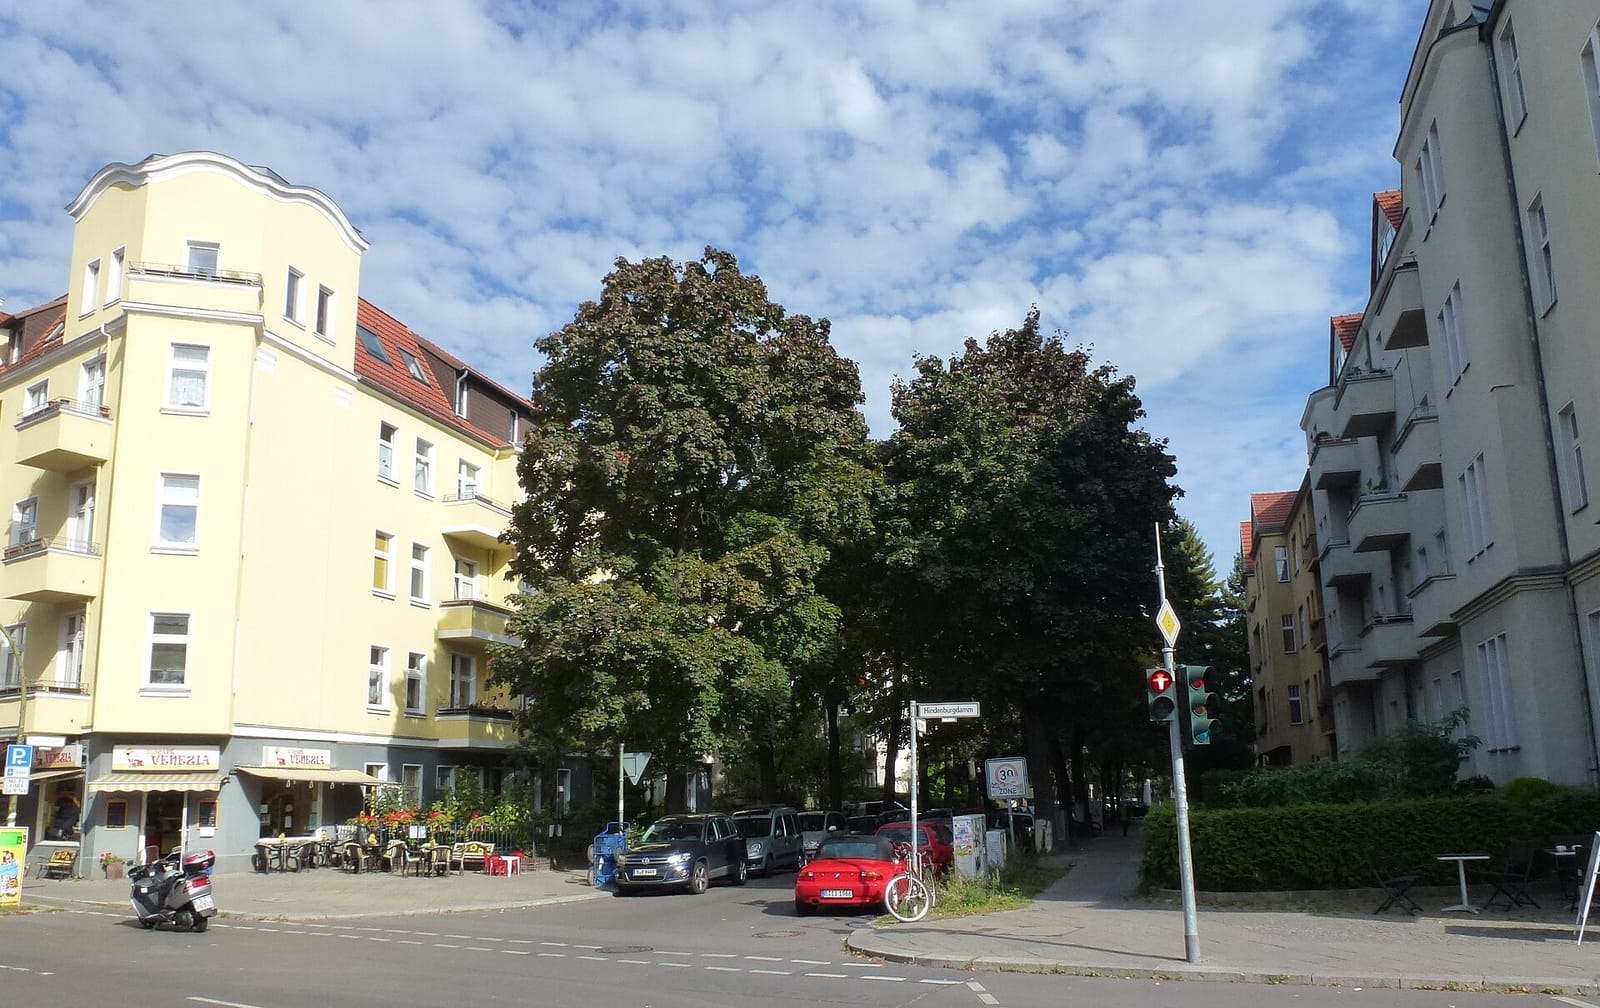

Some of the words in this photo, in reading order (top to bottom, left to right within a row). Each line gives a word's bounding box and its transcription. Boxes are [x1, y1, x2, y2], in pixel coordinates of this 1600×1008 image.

[923, 705, 974, 715] Hindenburgdamm
[12, 747, 26, 764] P
[151, 754, 210, 766] VENEZIA
[290, 753, 325, 765] VENEZIA
[1000, 787, 1018, 795] ZONE
